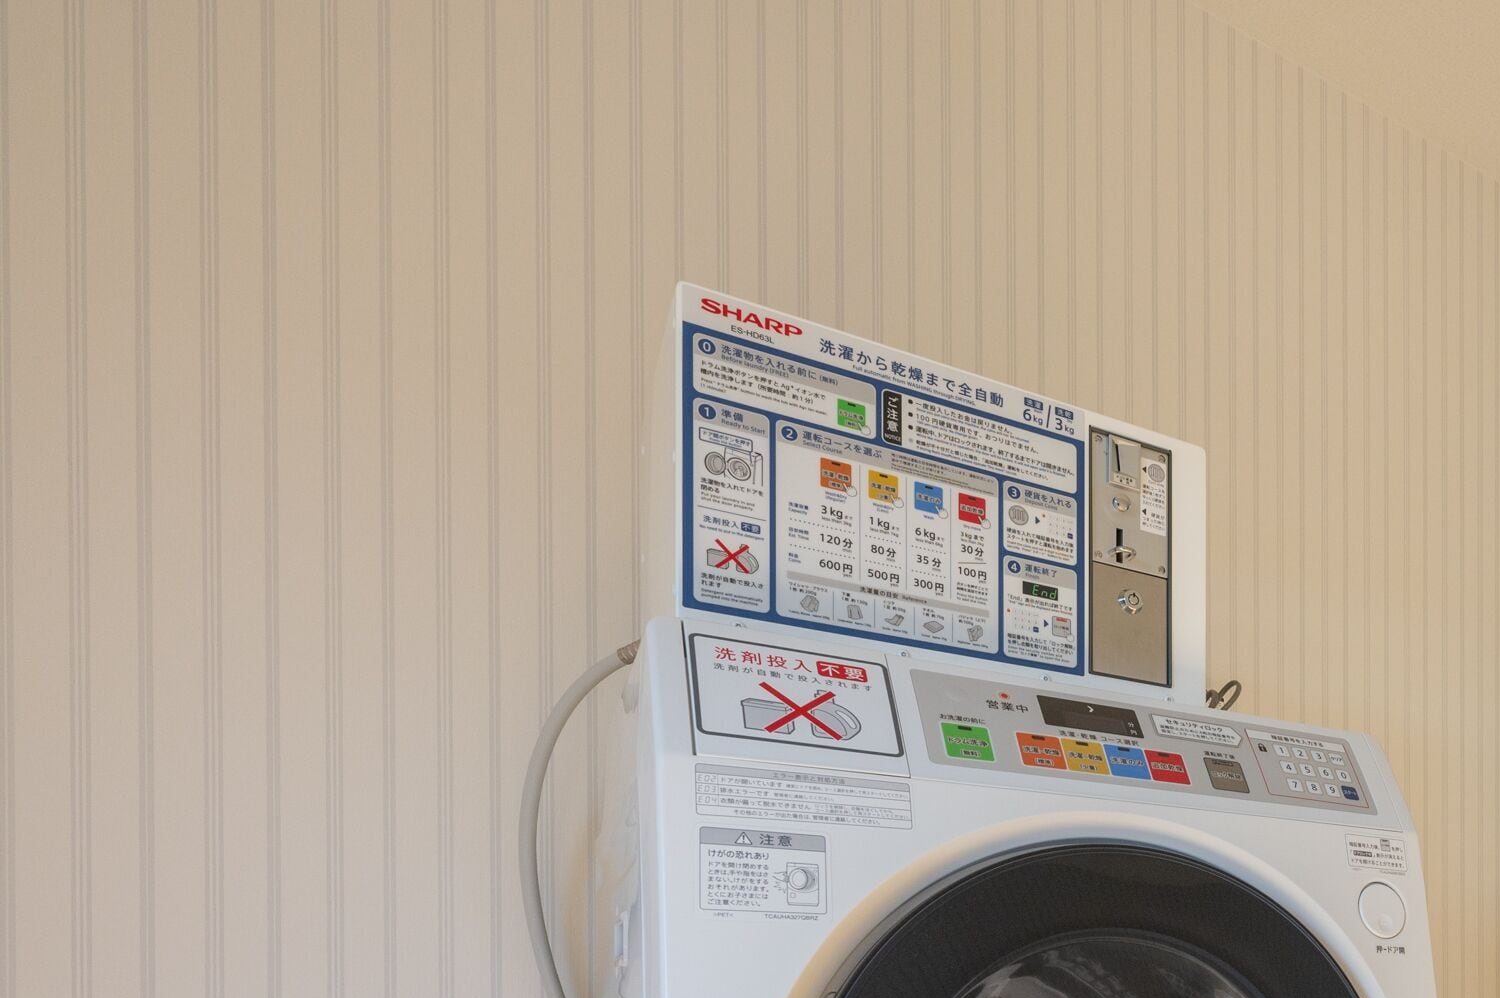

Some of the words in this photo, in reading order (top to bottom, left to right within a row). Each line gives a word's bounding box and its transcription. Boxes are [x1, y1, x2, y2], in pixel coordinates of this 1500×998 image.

[701, 298, 803, 336] SHARP
[702, 341, 712, 351] 0
[721, 355, 741, 366] Before
[721, 343, 817, 381] 洗濯物を入れる前に
[819, 337, 1004, 408] 洗濯から乾燥まで全自動
[721, 409, 743, 423] 準備
[886, 395, 900, 431] ご注意
[721, 419, 740, 429] Ready
[750, 425, 765, 435] Start
[802, 430, 882, 459] 運転コースを選ぶ
[802, 440, 821, 450] Select
[823, 445, 842, 455] Course
[1024, 489, 1072, 509] 硬貨を入れる
[703, 515, 739, 529] 洗剤投入
[820, 533, 853, 549] 120分
[871, 544, 896, 558] 80分
[961, 543, 984, 557] 30分
[819, 559, 853, 574] 600円
[917, 554, 941, 568] 35分
[868, 568, 900, 584] 500円
[958, 567, 987, 581] 100円
[1024, 563, 1057, 578] 運転終了
[701, 572, 763, 589] 洗剤が自動で投入さ
[914, 578, 944, 593] 300円
[1032, 584, 1057, 600] End
[714, 646, 812, 673] 洗剤投入
[820, 663, 865, 682] 不要
[713, 662, 872, 692] 洗剤が自動で投入されます
[986, 700, 1030, 714] 営業中
[940, 713, 985, 725] お洗濯の前に
[948, 736, 988, 748] ドラム洗浄
[1279, 746, 1285, 755] 1
[1298, 749, 1304, 758] 2
[1315, 752, 1322, 760] 3
[1285, 763, 1292, 772] 4
[1304, 766, 1311, 774] 5
[1323, 769, 1330, 777] 6
[1340, 771, 1347, 780] 0
[1292, 781, 1298, 790] 7
[1311, 783, 1318, 792] 8
[1329, 786, 1336, 795] 9
[759, 833, 793, 847] 注意
[708, 849, 769, 860] けがの恐れあり
[708, 861, 769, 871] ドアを開け閉めする
[708, 892, 769, 900] とくにお子さまには
[708, 899, 761, 907] ご注意ください。
